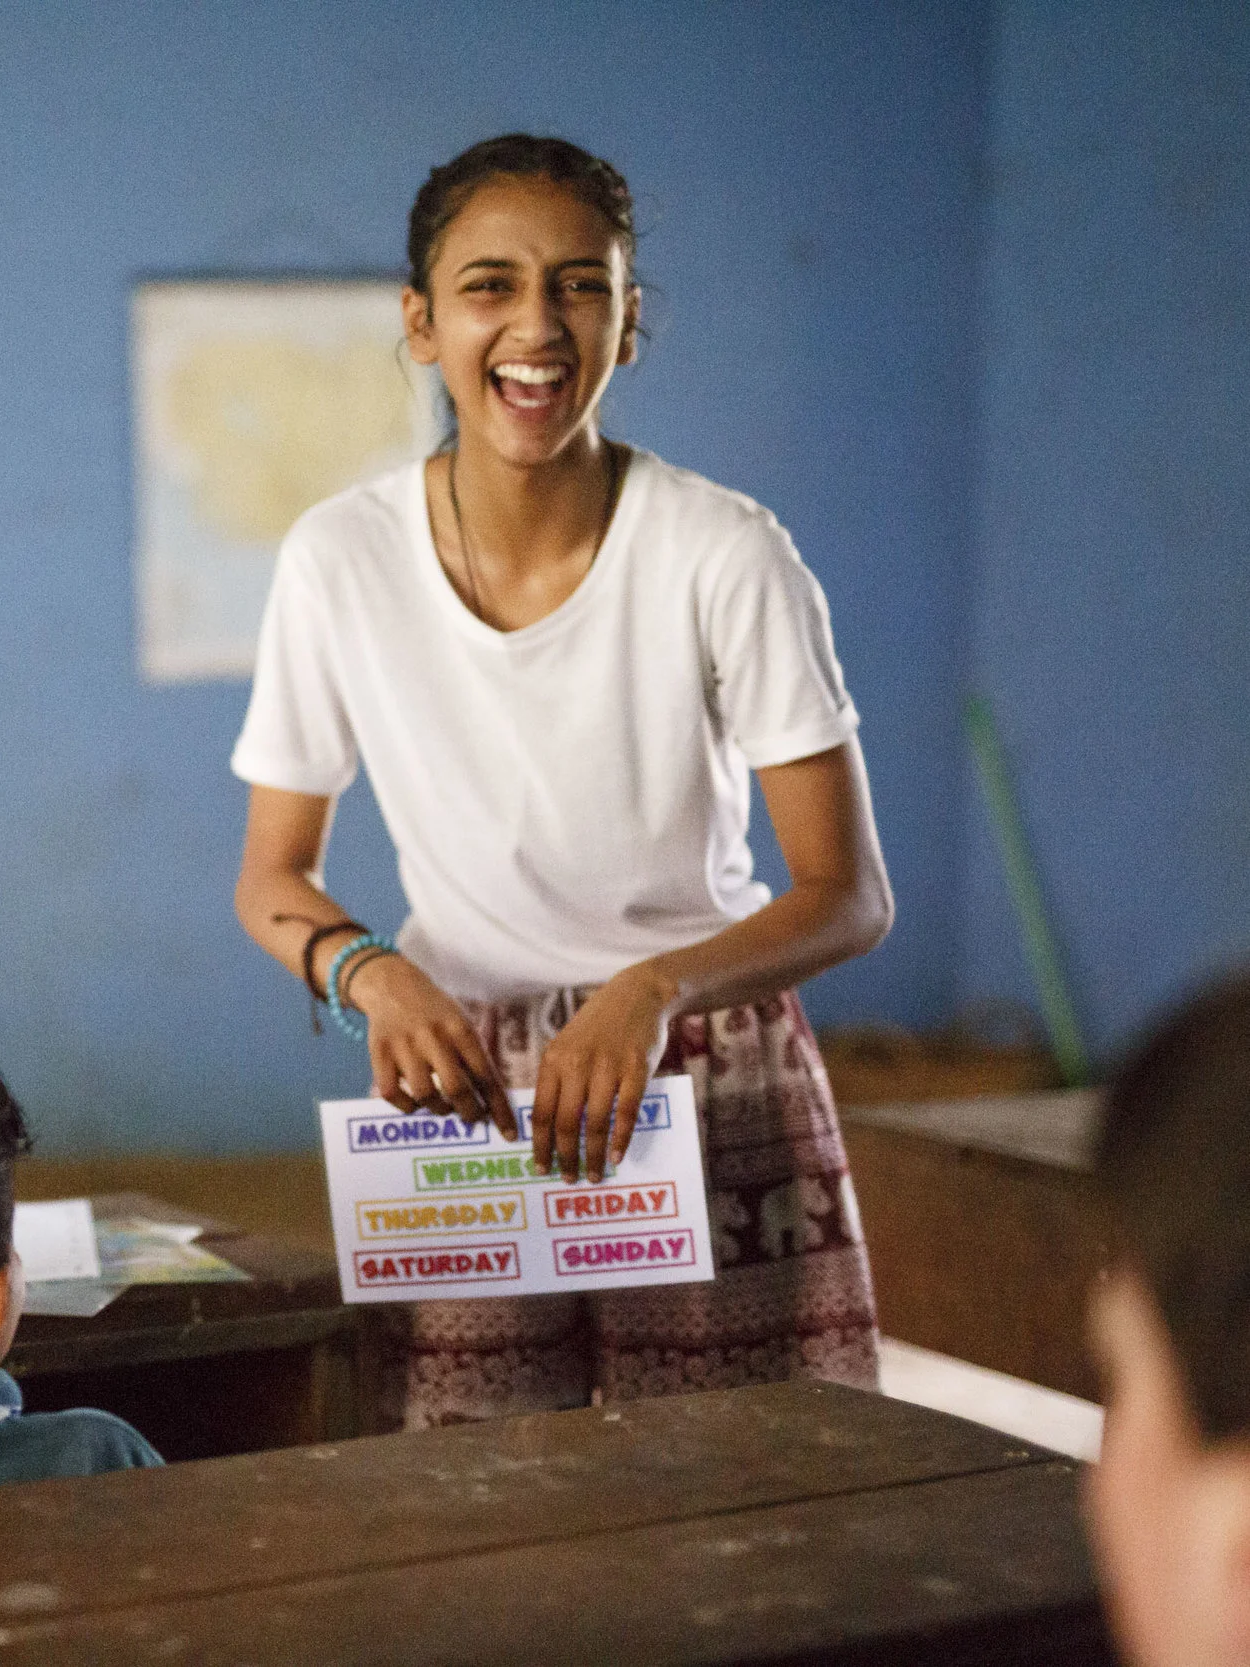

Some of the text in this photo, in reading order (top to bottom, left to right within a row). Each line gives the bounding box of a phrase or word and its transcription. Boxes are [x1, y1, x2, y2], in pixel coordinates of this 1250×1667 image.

[358, 1119, 474, 1144] MONDAY
[364, 1202, 517, 1232] THURSDAY
[555, 1190, 667, 1220] FRIDAY
[361, 1251, 511, 1279] SATURDAY
[563, 1237, 685, 1268] SUNDAY
